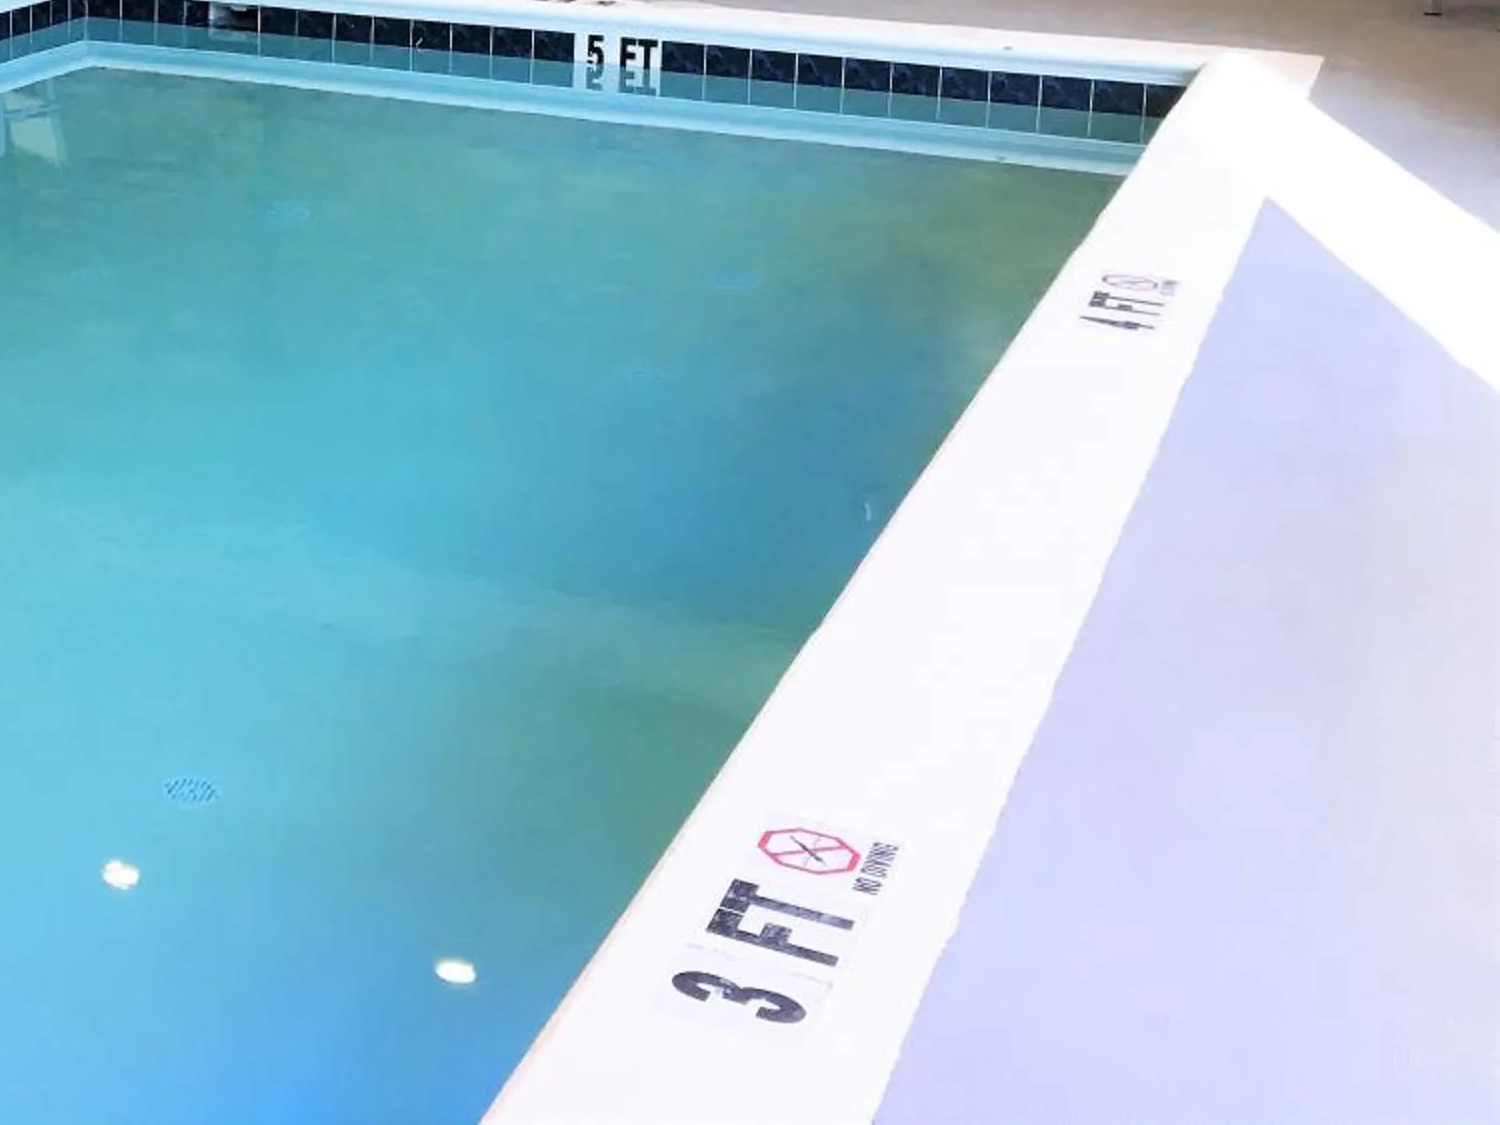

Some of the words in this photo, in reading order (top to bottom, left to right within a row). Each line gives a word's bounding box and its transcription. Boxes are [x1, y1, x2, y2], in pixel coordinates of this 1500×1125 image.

[587, 35, 604, 65] 5
[620, 37, 658, 69] FT
[1089, 291, 1165, 316] FT
[860, 842, 898, 879] DIVING
[852, 877, 883, 895] NO
[706, 878, 855, 967] FT
[672, 970, 806, 1024] 3
